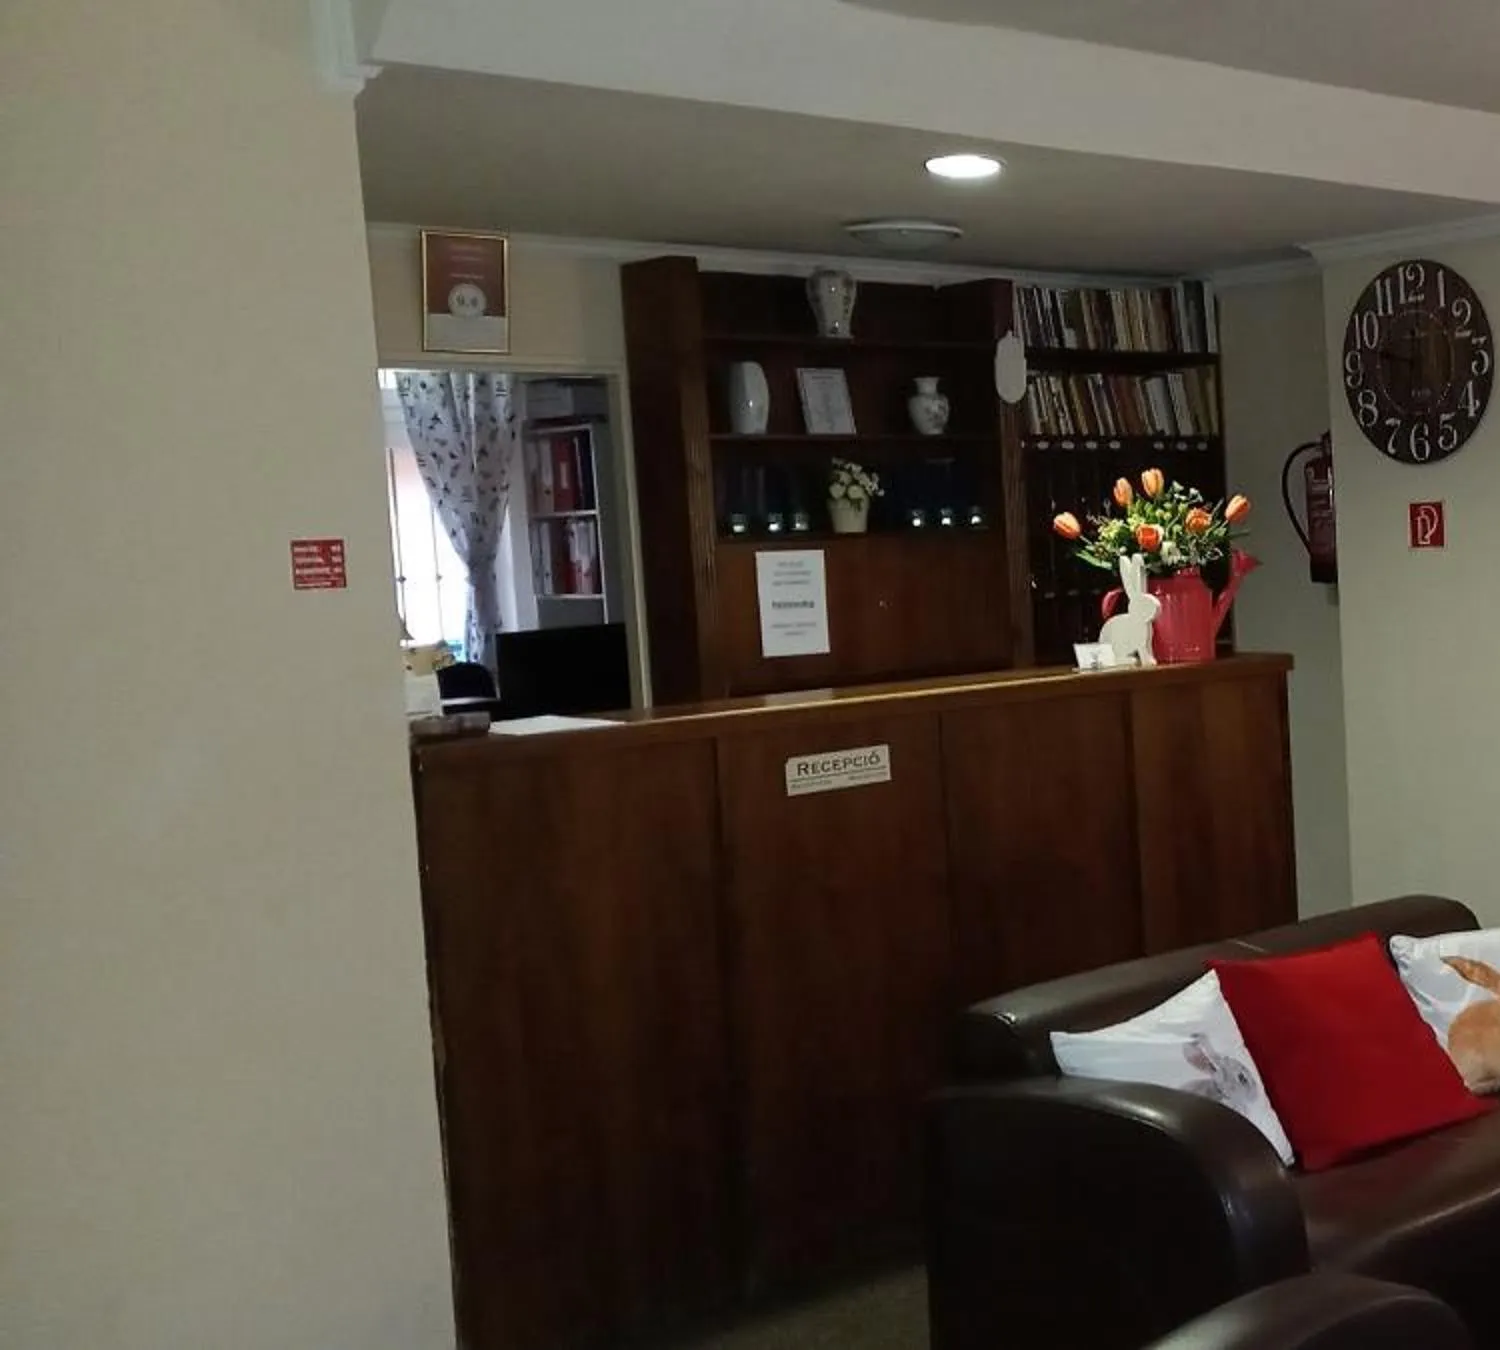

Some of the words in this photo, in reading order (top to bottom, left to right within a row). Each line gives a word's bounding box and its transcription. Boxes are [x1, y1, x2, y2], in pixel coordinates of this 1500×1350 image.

[1375, 278, 1393, 317] 11
[1398, 263, 1425, 305] 12
[1437, 269, 1446, 308] 1
[1355, 310, 1380, 350] 10
[1451, 299, 1472, 338] 2
[1345, 350, 1363, 388] 9
[1471, 335, 1489, 376] 3
[1358, 389, 1379, 427] 8
[1457, 380, 1480, 417] 4
[1385, 418, 1401, 454] 7
[1410, 422, 1430, 461] 6
[1438, 412, 1457, 451] 5
[797, 751, 881, 776] RECEPCIÓ
